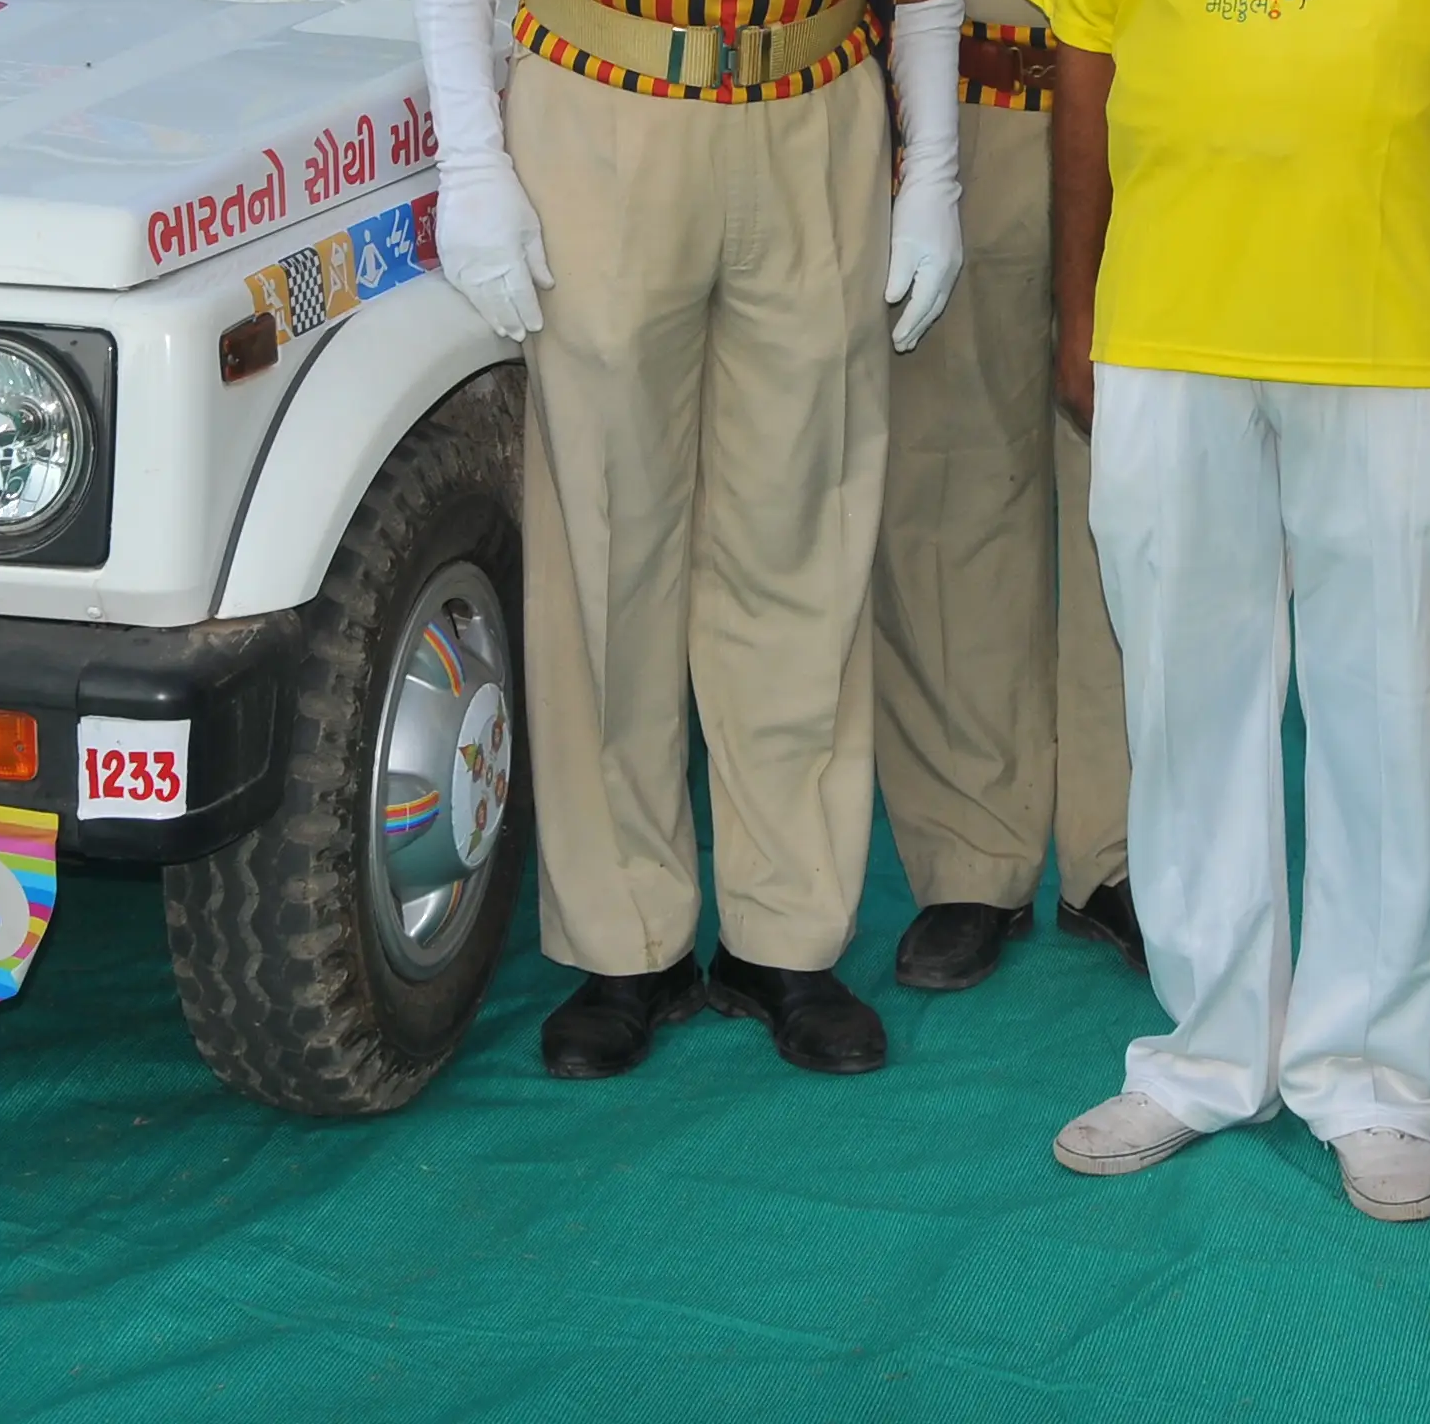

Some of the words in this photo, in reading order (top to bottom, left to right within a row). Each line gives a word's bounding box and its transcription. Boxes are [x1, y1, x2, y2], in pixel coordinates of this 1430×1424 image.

[147, 147, 287, 267] ભારતનો
[390, 96, 439, 167] મોટ
[84, 747, 182, 803] 1233
